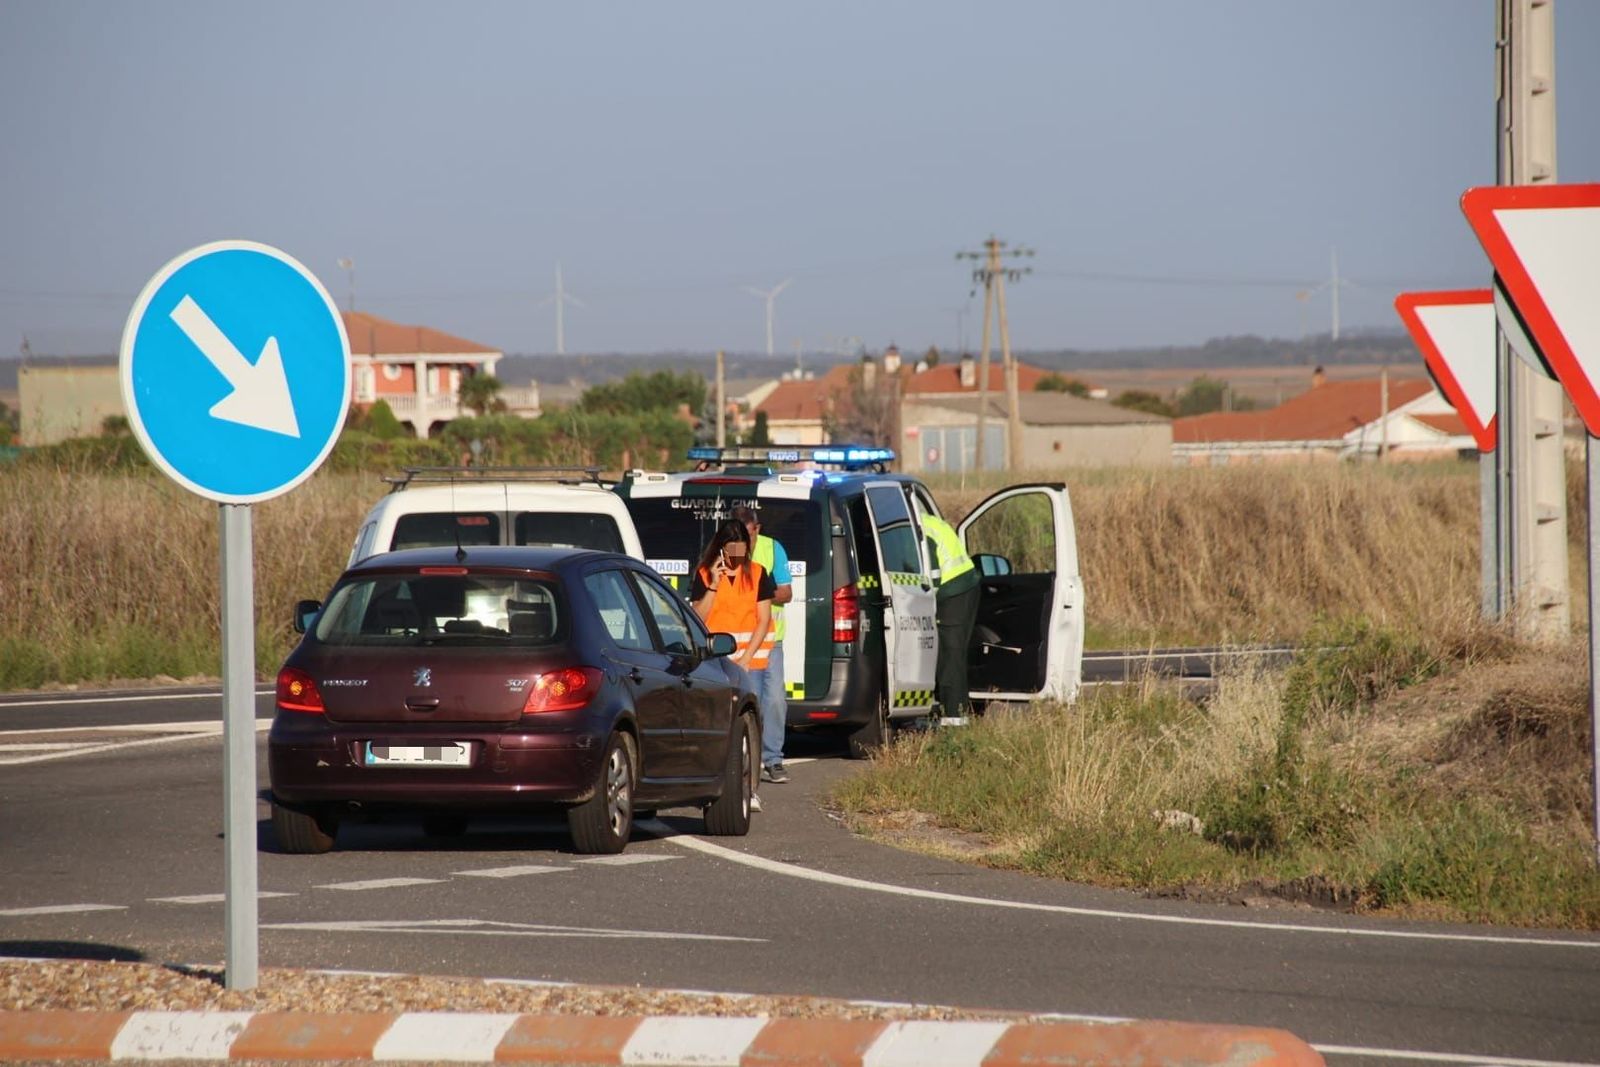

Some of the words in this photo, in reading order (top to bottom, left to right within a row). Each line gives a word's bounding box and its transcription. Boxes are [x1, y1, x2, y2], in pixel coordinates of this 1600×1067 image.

[671, 499, 726, 509] GUARDIA
[731, 499, 762, 509] CIVIL
[323, 679, 368, 687] PEUGEOT
[506, 679, 528, 687] 307
